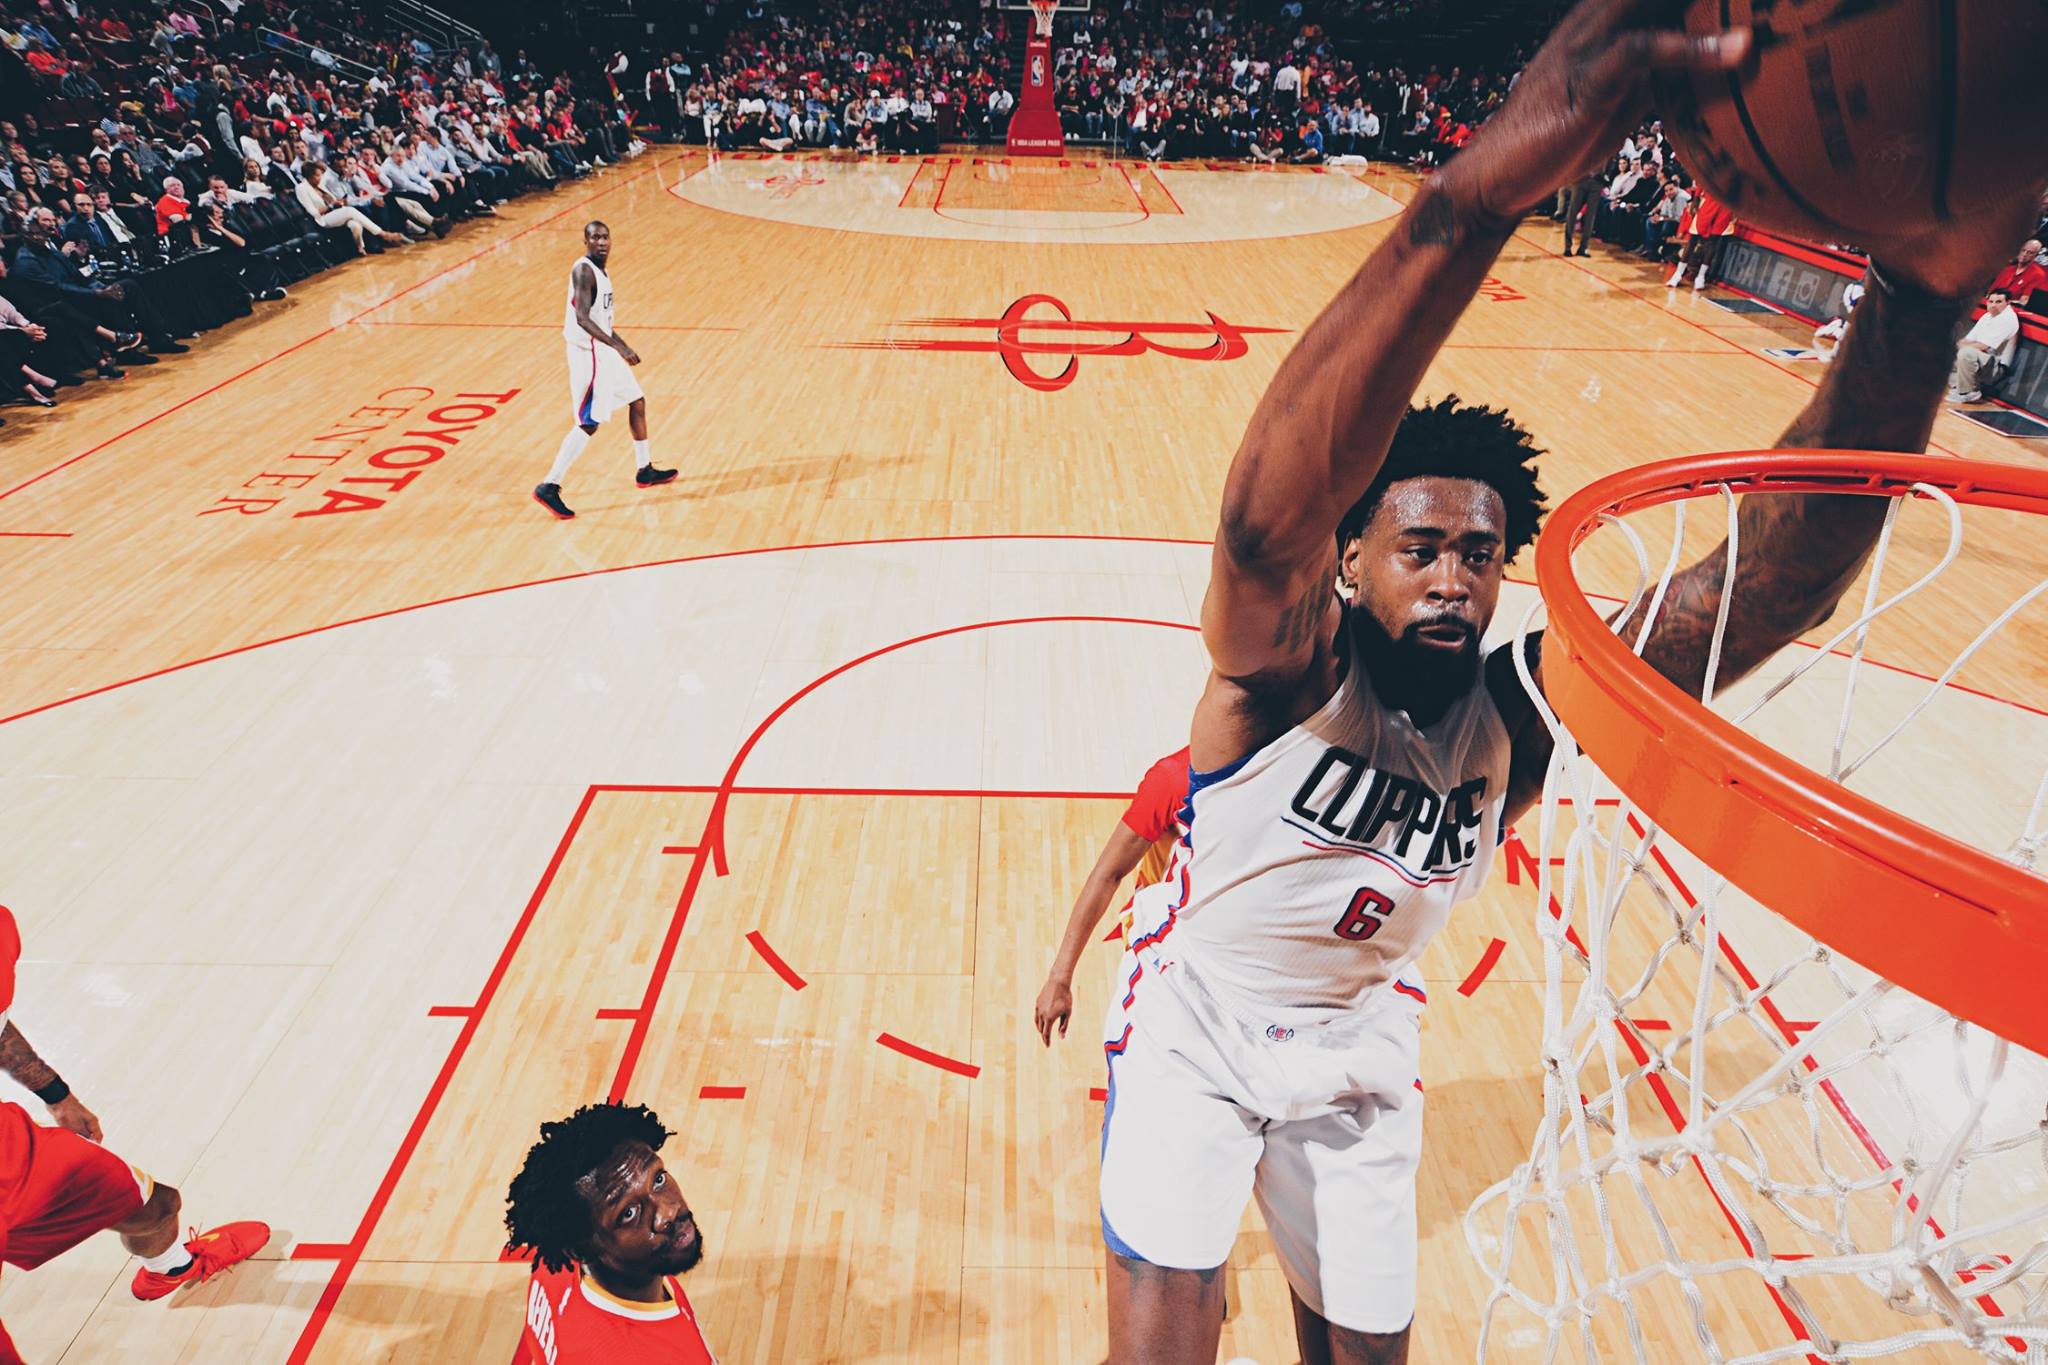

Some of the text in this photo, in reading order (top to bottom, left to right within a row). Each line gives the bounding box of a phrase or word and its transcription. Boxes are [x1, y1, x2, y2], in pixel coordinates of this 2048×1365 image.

[195, 386, 435, 517] CENTER
[292, 388, 522, 518] TOYOTA
[1291, 745, 1487, 871] CLIPPRS
[1333, 886, 1395, 941] 6
